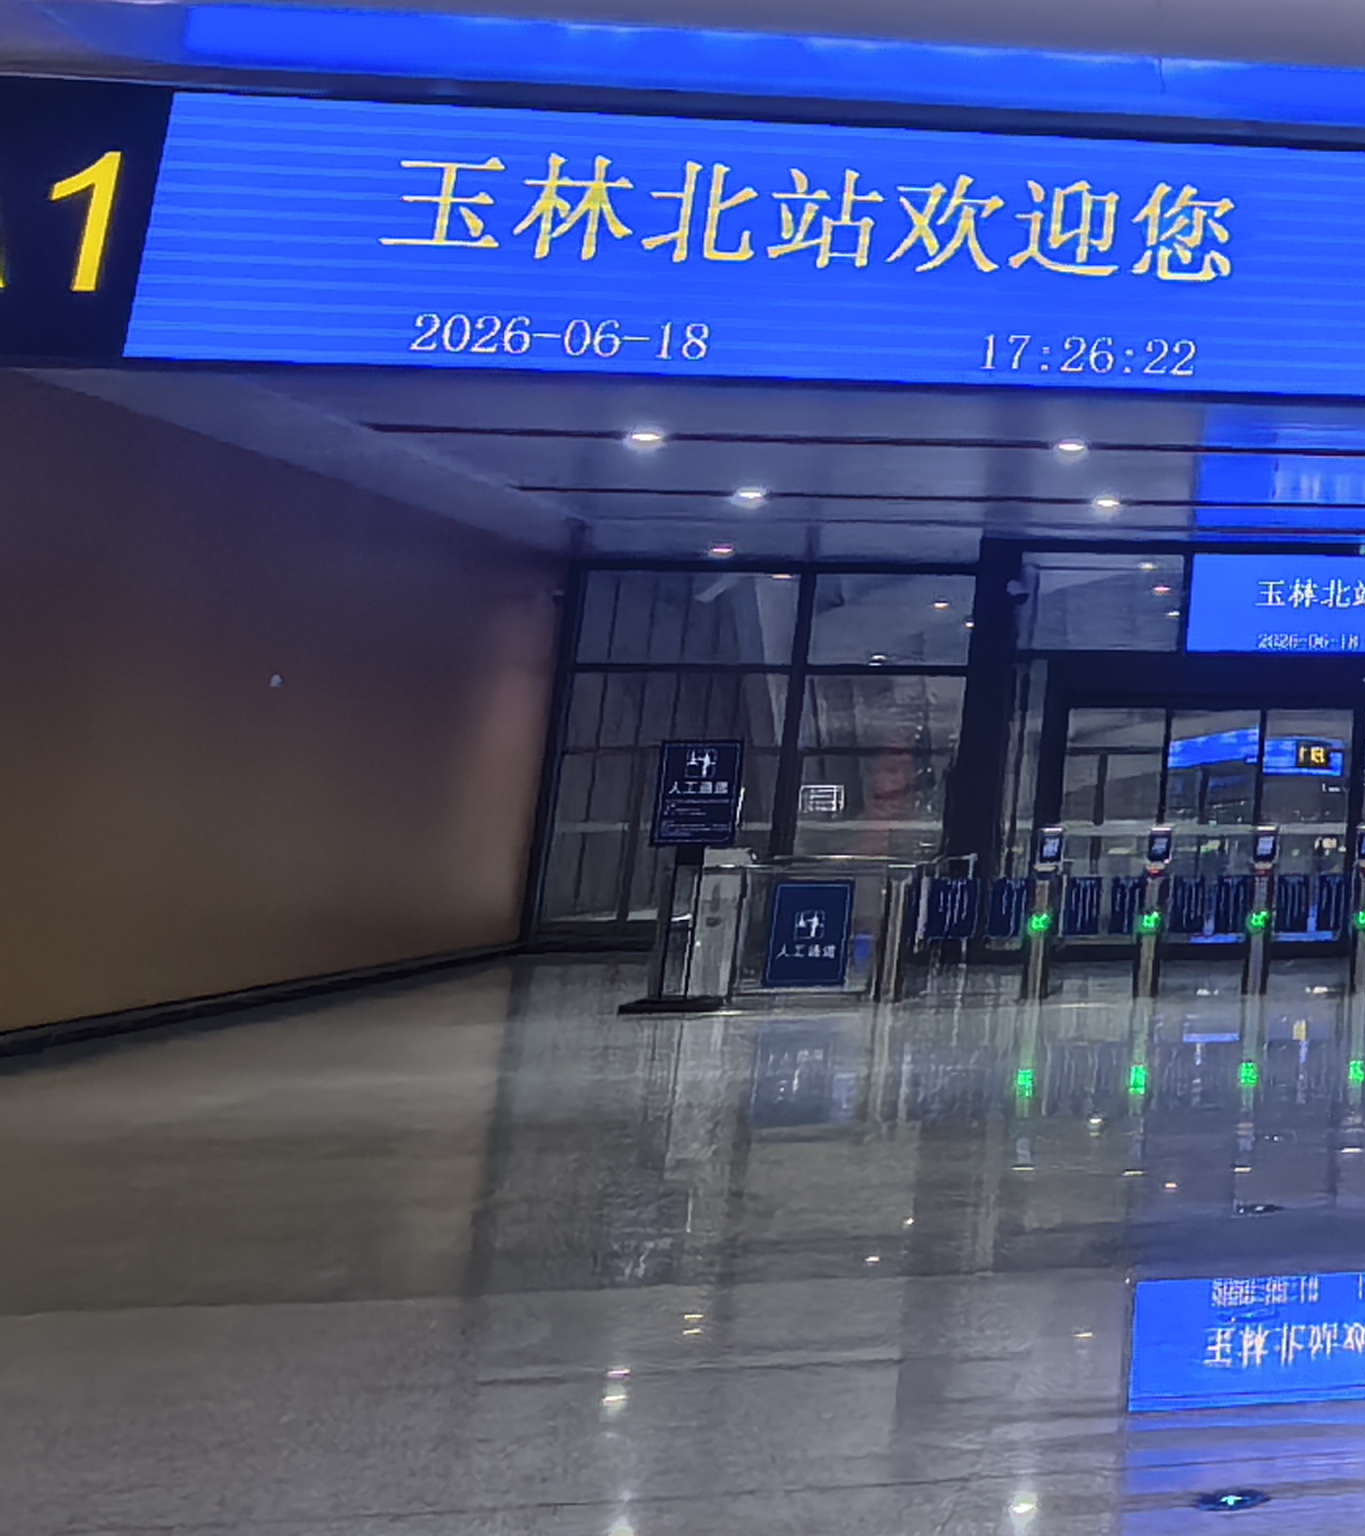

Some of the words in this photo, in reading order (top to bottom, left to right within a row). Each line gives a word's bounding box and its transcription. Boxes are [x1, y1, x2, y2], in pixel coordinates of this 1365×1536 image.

[380, 154, 1234, 281] 玉林北站欢迎您
[410, 315, 708, 358] 2026-06-18
[980, 334, 1196, 377] 17:26:22
